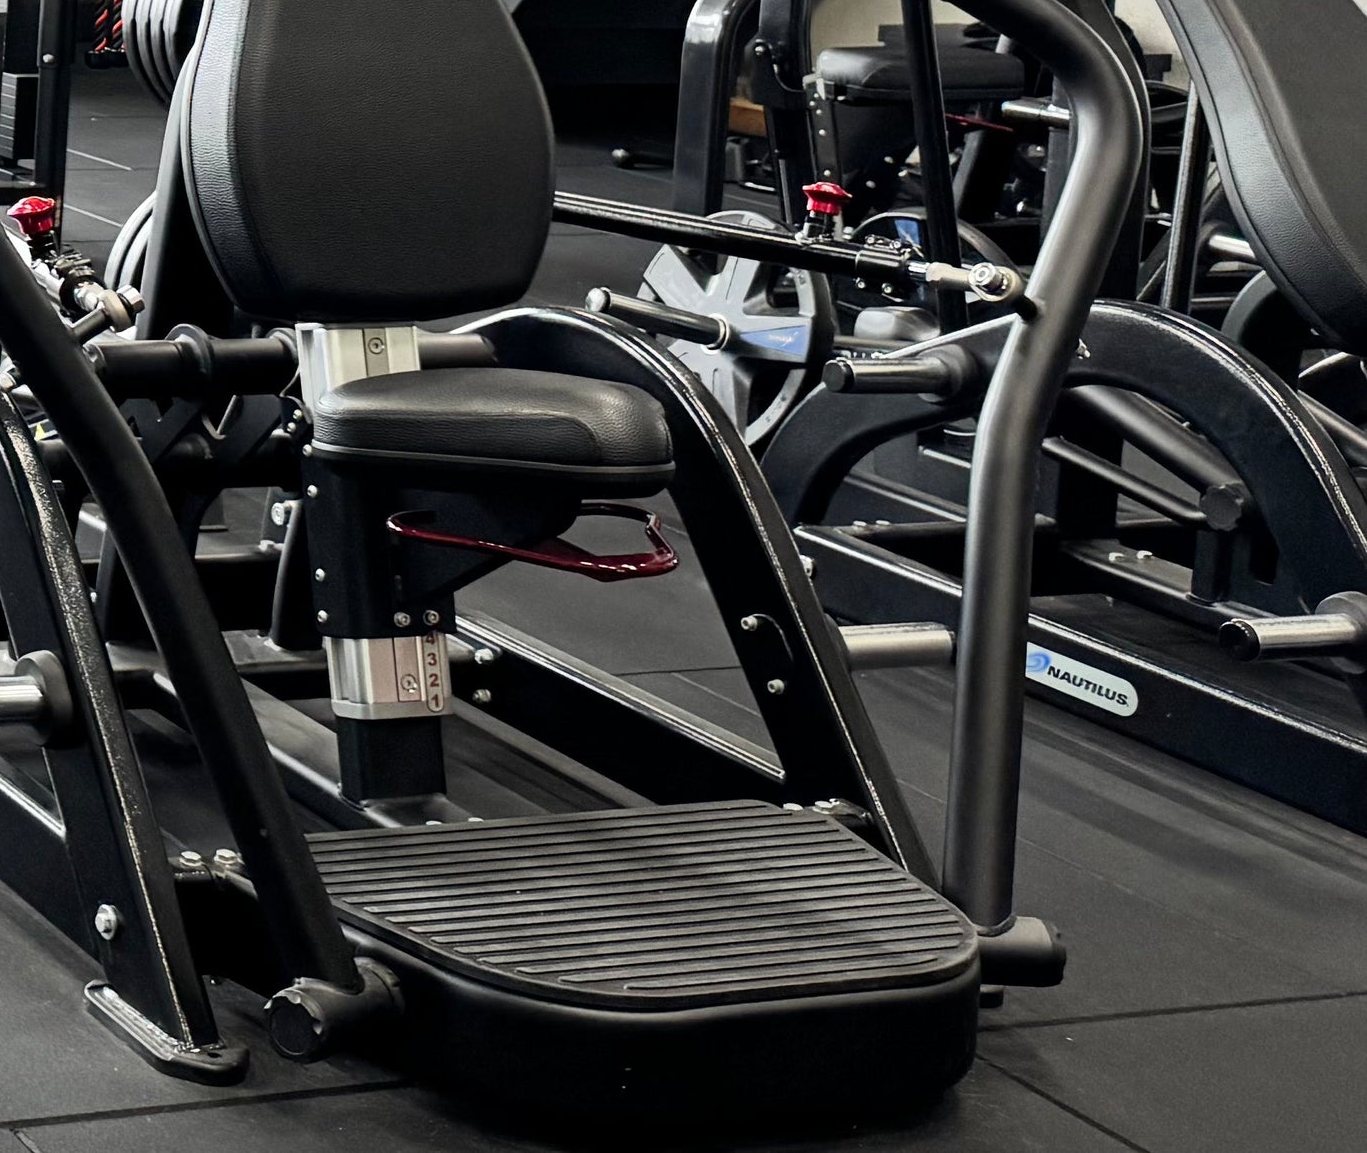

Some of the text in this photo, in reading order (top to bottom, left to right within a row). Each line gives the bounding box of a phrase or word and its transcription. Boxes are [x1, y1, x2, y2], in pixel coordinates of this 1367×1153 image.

[427, 652, 437, 666] 3
[429, 673, 439, 688] 2
[1047, 665, 1129, 707] NAUTILUS
[431, 694, 440, 708] 1
